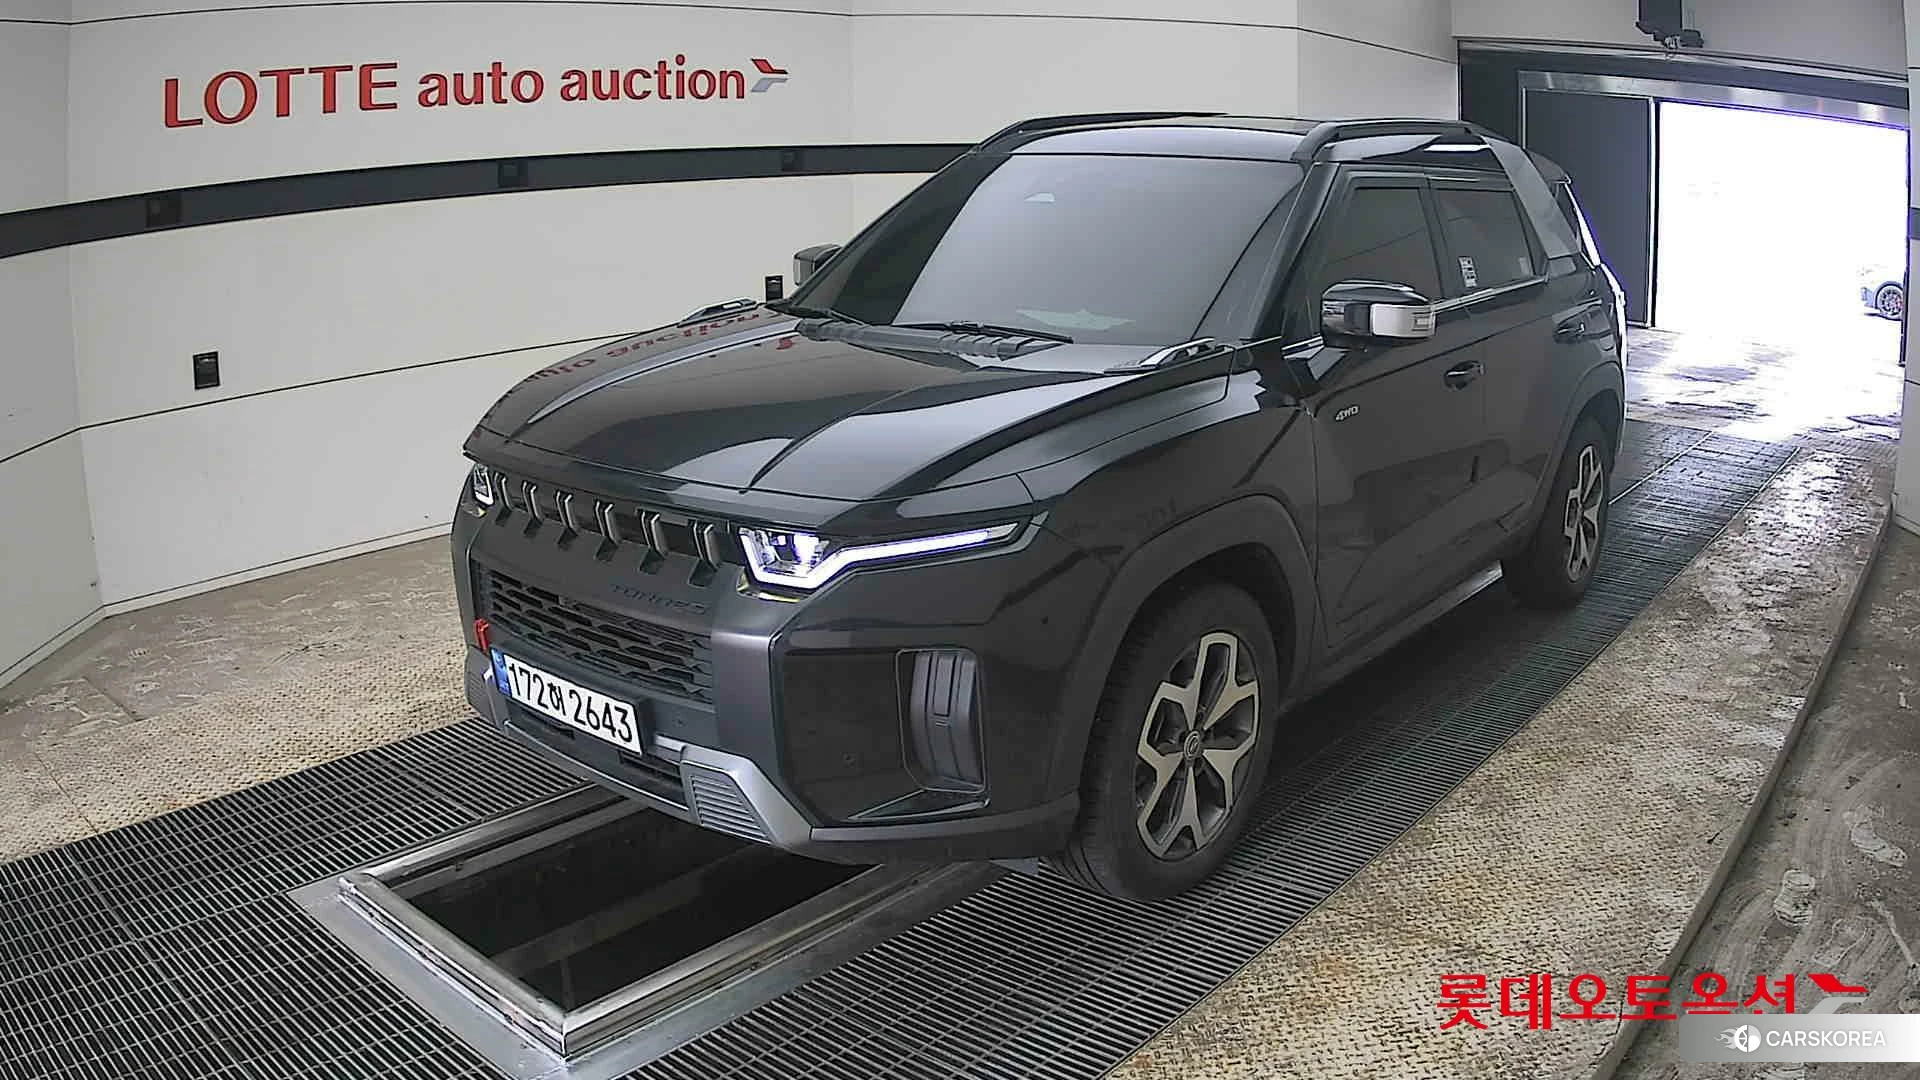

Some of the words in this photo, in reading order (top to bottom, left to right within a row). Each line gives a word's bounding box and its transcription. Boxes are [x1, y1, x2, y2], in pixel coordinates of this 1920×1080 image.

[164, 62, 399, 129] LOTTE
[417, 62, 545, 108] auto
[559, 54, 747, 102] auction
[1335, 405, 1359, 421] 4WD
[569, 688, 633, 743] 2643
